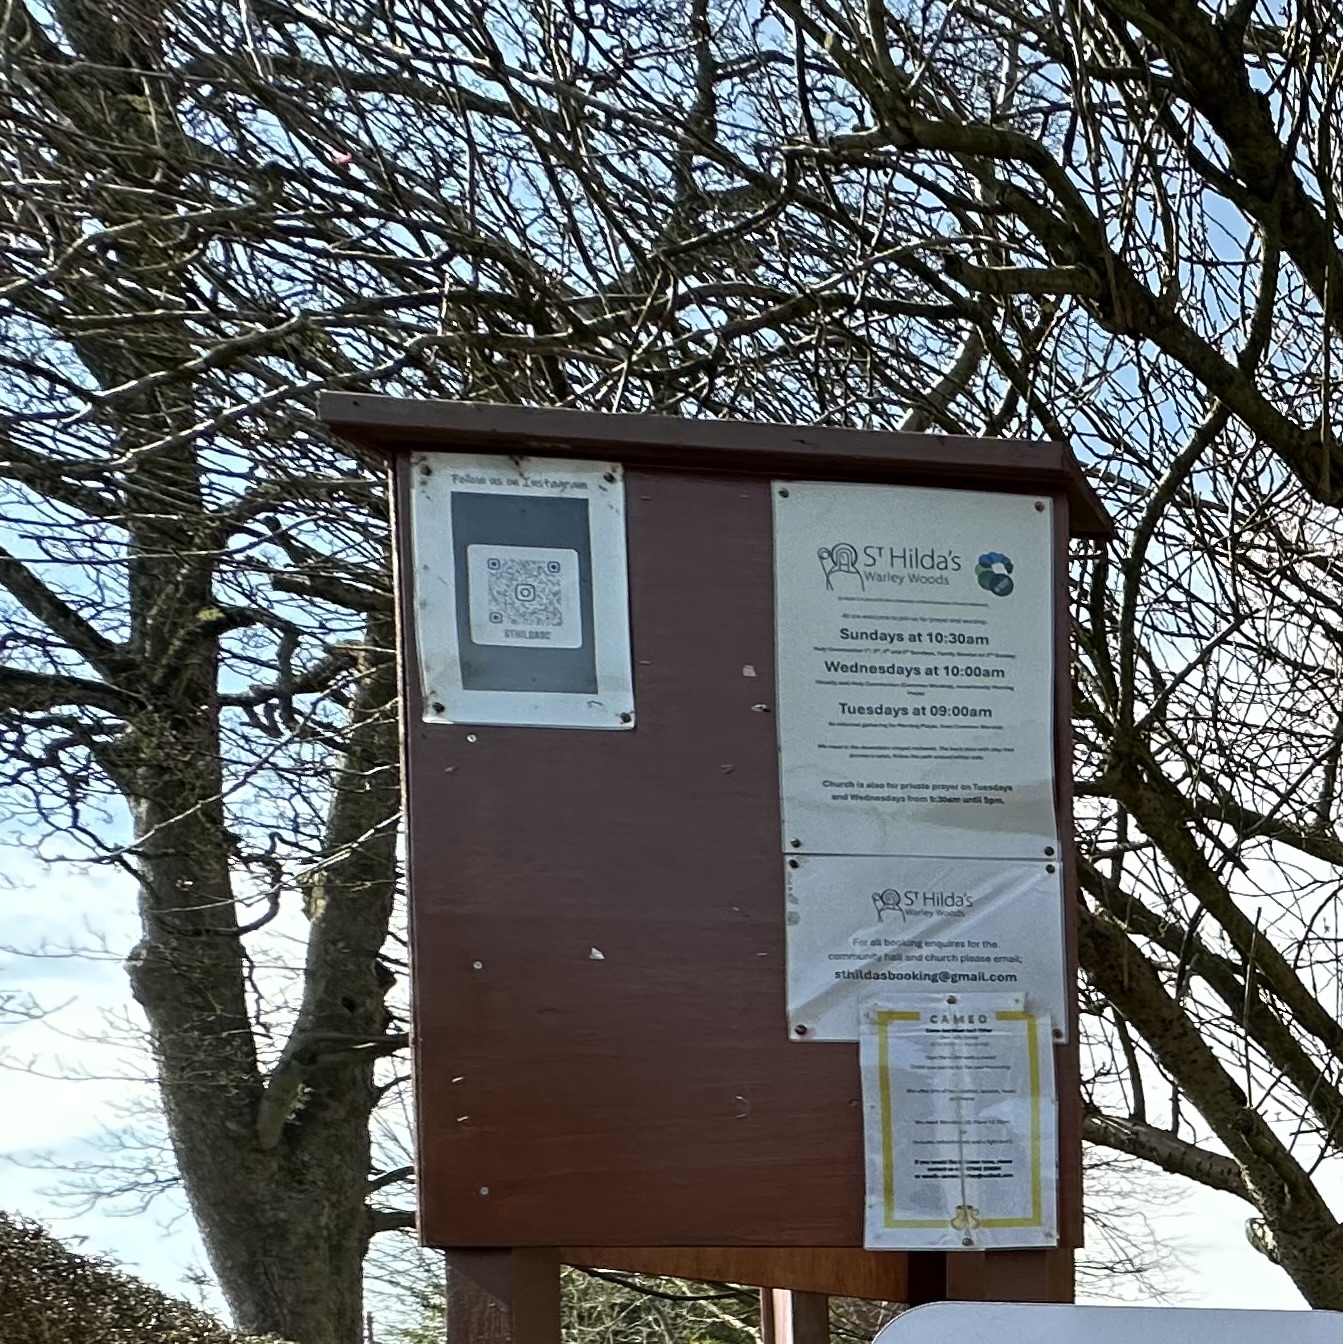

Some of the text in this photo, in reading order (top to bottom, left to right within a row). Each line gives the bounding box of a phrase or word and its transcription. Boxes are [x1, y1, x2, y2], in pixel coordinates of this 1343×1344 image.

[522, 476, 588, 493] Instagram
[890, 547, 962, 572] Hilda's
[864, 571, 950, 586] Warley Woods
[839, 627, 990, 646] Sundays at 10:30am
[824, 660, 1006, 679] Wednesdays at 10:00am
[838, 702, 993, 719] Tuesdays at 09:00am
[822, 779, 855, 789] Church
[900, 782, 931, 792] private
[931, 783, 959, 793] prayer
[960, 784, 972, 792] on
[972, 783, 1013, 793] Tuesdays
[850, 793, 907, 804] Wednesdays
[923, 891, 974, 908] Hilda's
[853, 938, 868, 947] For
[869, 938, 882, 947] all
[883, 938, 924, 949] booking
[967, 939, 981, 949] for
[981, 940, 998, 949] the
[828, 953, 882, 963] community
[884, 952, 902, 962] hall
[904, 953, 923, 963] and
[924, 953, 958, 963] church
[960, 954, 991, 964] please
[834, 969, 1018, 984] sthildasbooking@gmail.com
